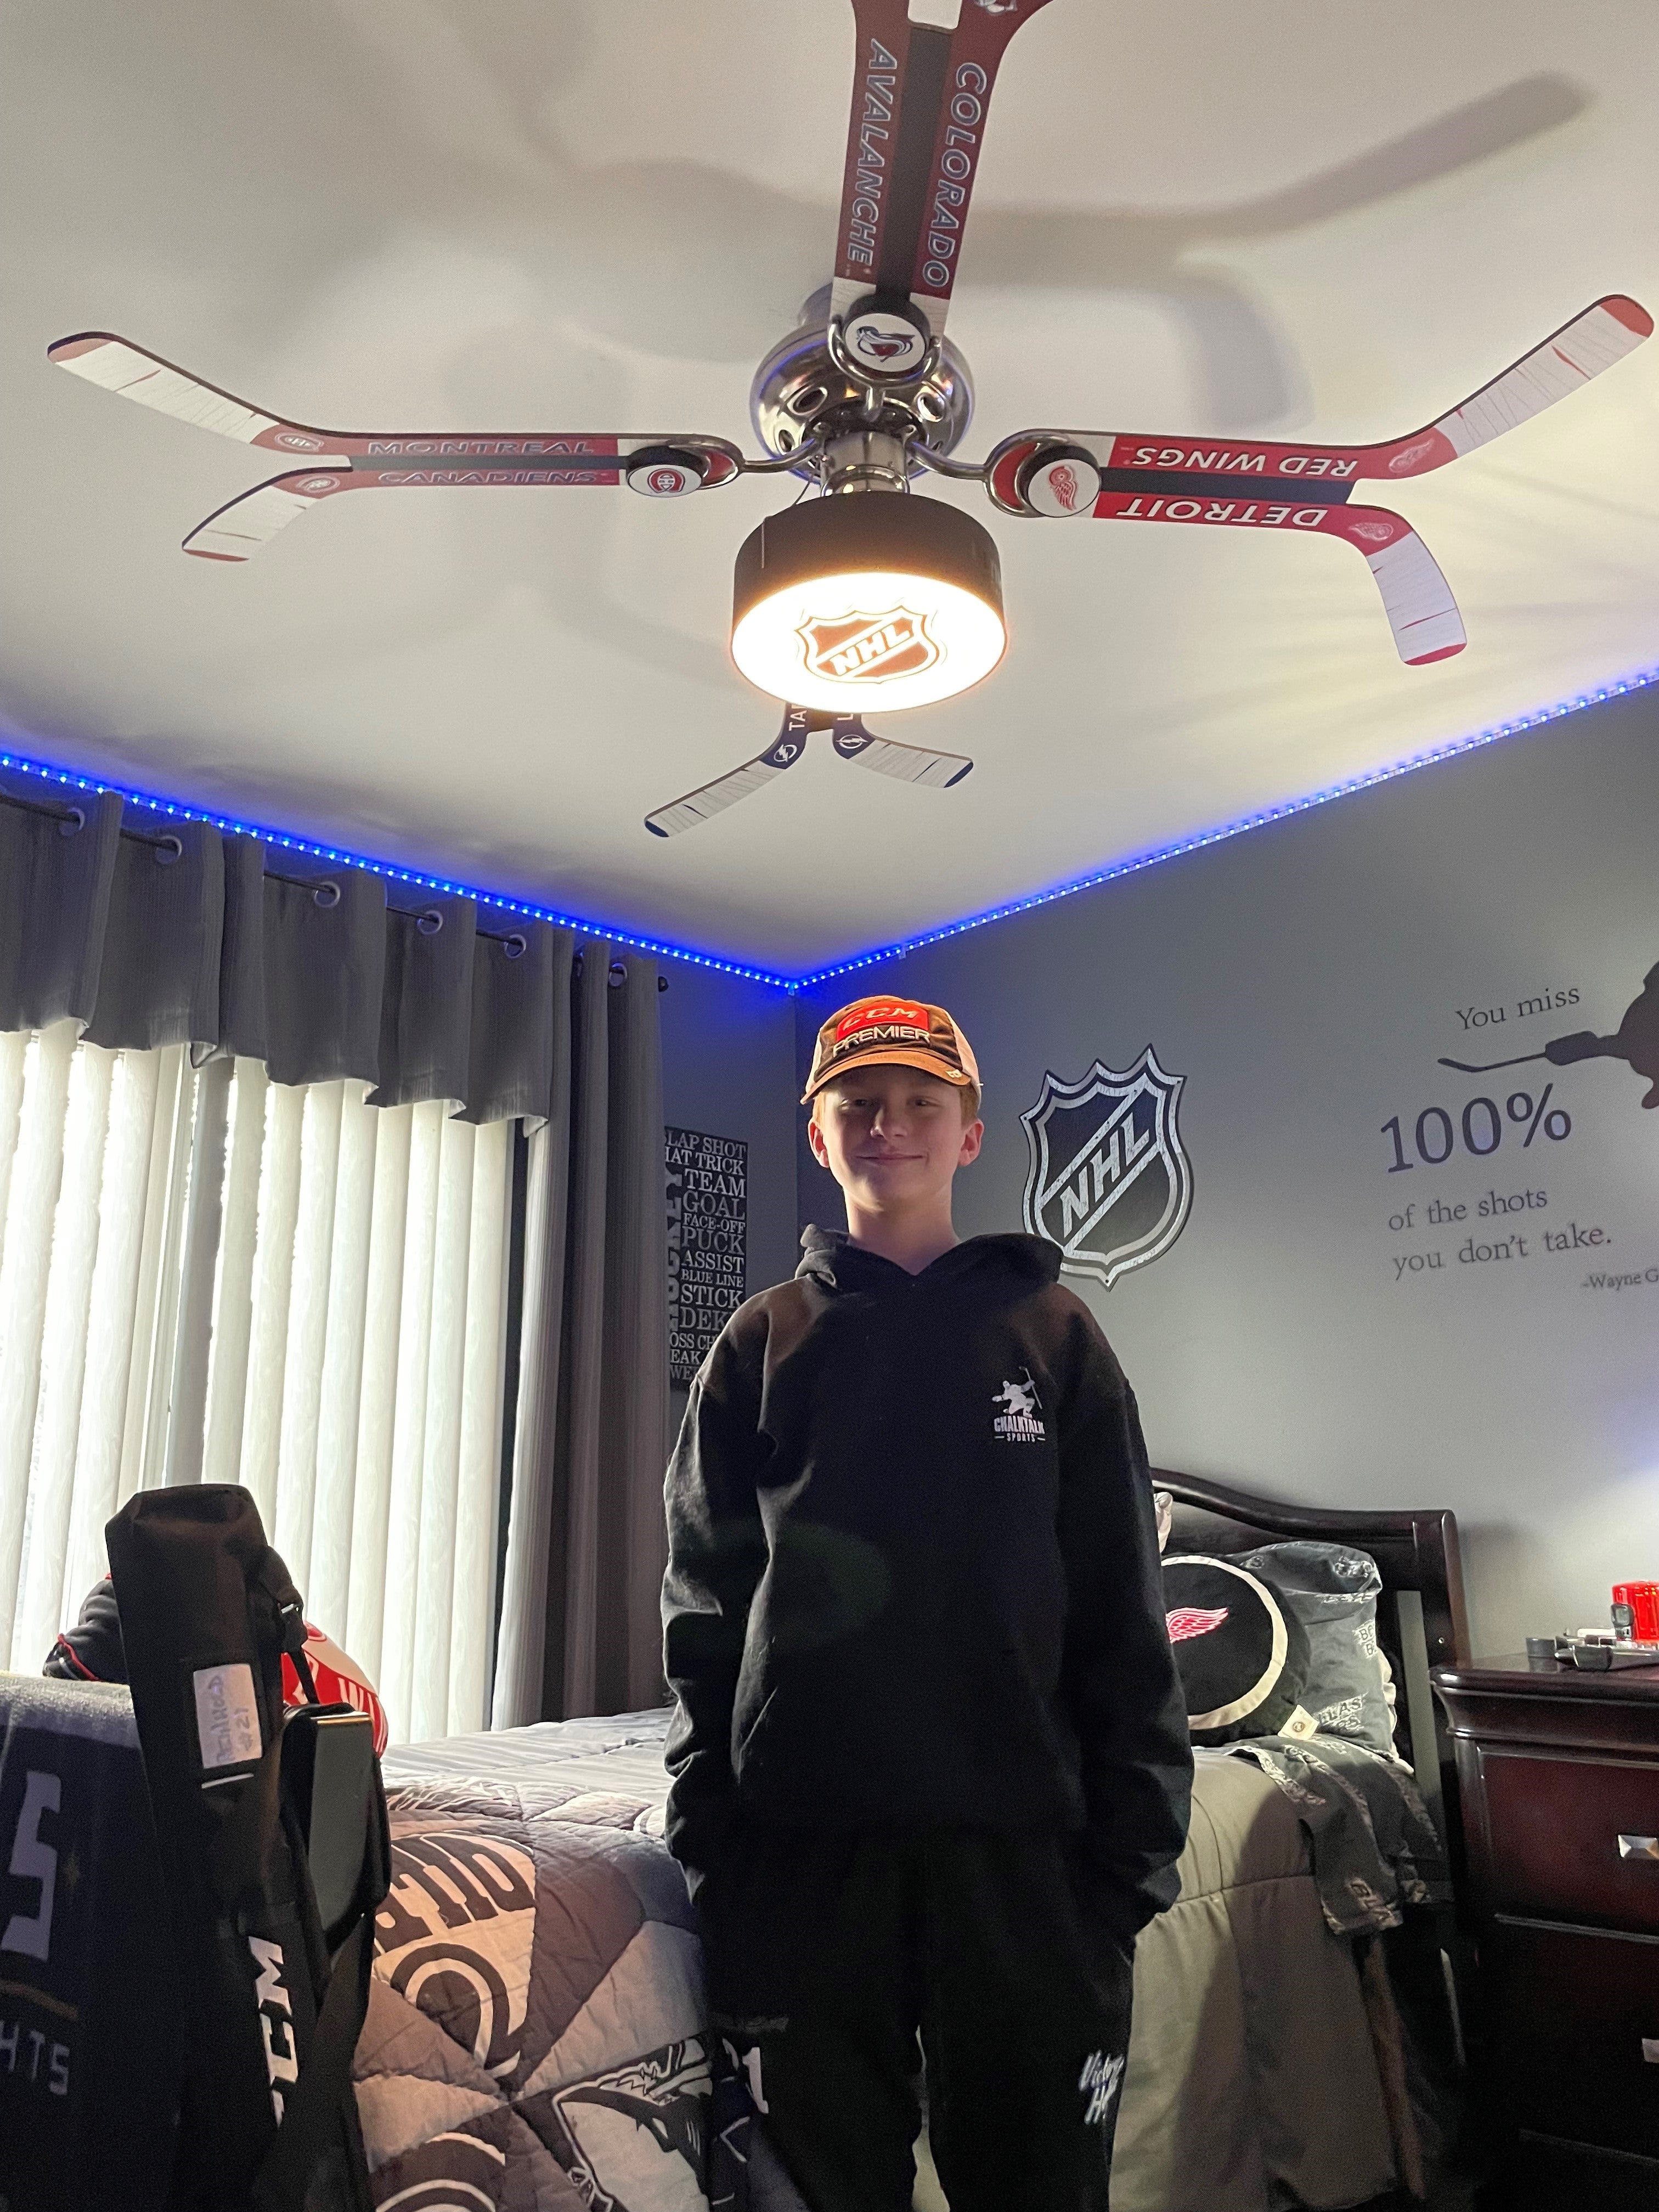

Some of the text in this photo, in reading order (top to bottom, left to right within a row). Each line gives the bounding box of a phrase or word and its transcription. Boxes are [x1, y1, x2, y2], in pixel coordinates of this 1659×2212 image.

[847, 38, 898, 266] AVALANCHE
[923, 62, 987, 287] COLORADO
[367, 441, 595, 456] MONTREAL
[1132, 447, 1358, 478] RED WINGS
[379, 471, 596, 484] CANADIENS
[1118, 497, 1329, 527] DETROIT
[830, 623, 912, 676] NHL
[842, 1007, 920, 1031] CCM
[1455, 988, 1580, 1030] You miss
[833, 1025, 930, 1058] PREMIER
[1380, 1083, 1571, 1173] 100%
[665, 1130, 746, 1160] LAP SHOT
[695, 1152, 744, 1176] TRICK
[1059, 1111, 1150, 1238] NHL
[684, 1167, 746, 1198] TEAM
[682, 1189, 746, 1220] GOAL
[1389, 1189, 1548, 1231] of the shots
[684, 1212, 746, 1234] FACE-OFF
[681, 1226, 745, 1255] PUCK
[1392, 1222, 1612, 1280] you don't take.
[681, 1249, 744, 1273] ASSIST
[680, 1268, 744, 1288] BLUE LINE
[680, 1283, 743, 1309] STICK
[679, 1306, 732, 1331] DEK
[1007, 1432, 1035, 1442] SPORTS
